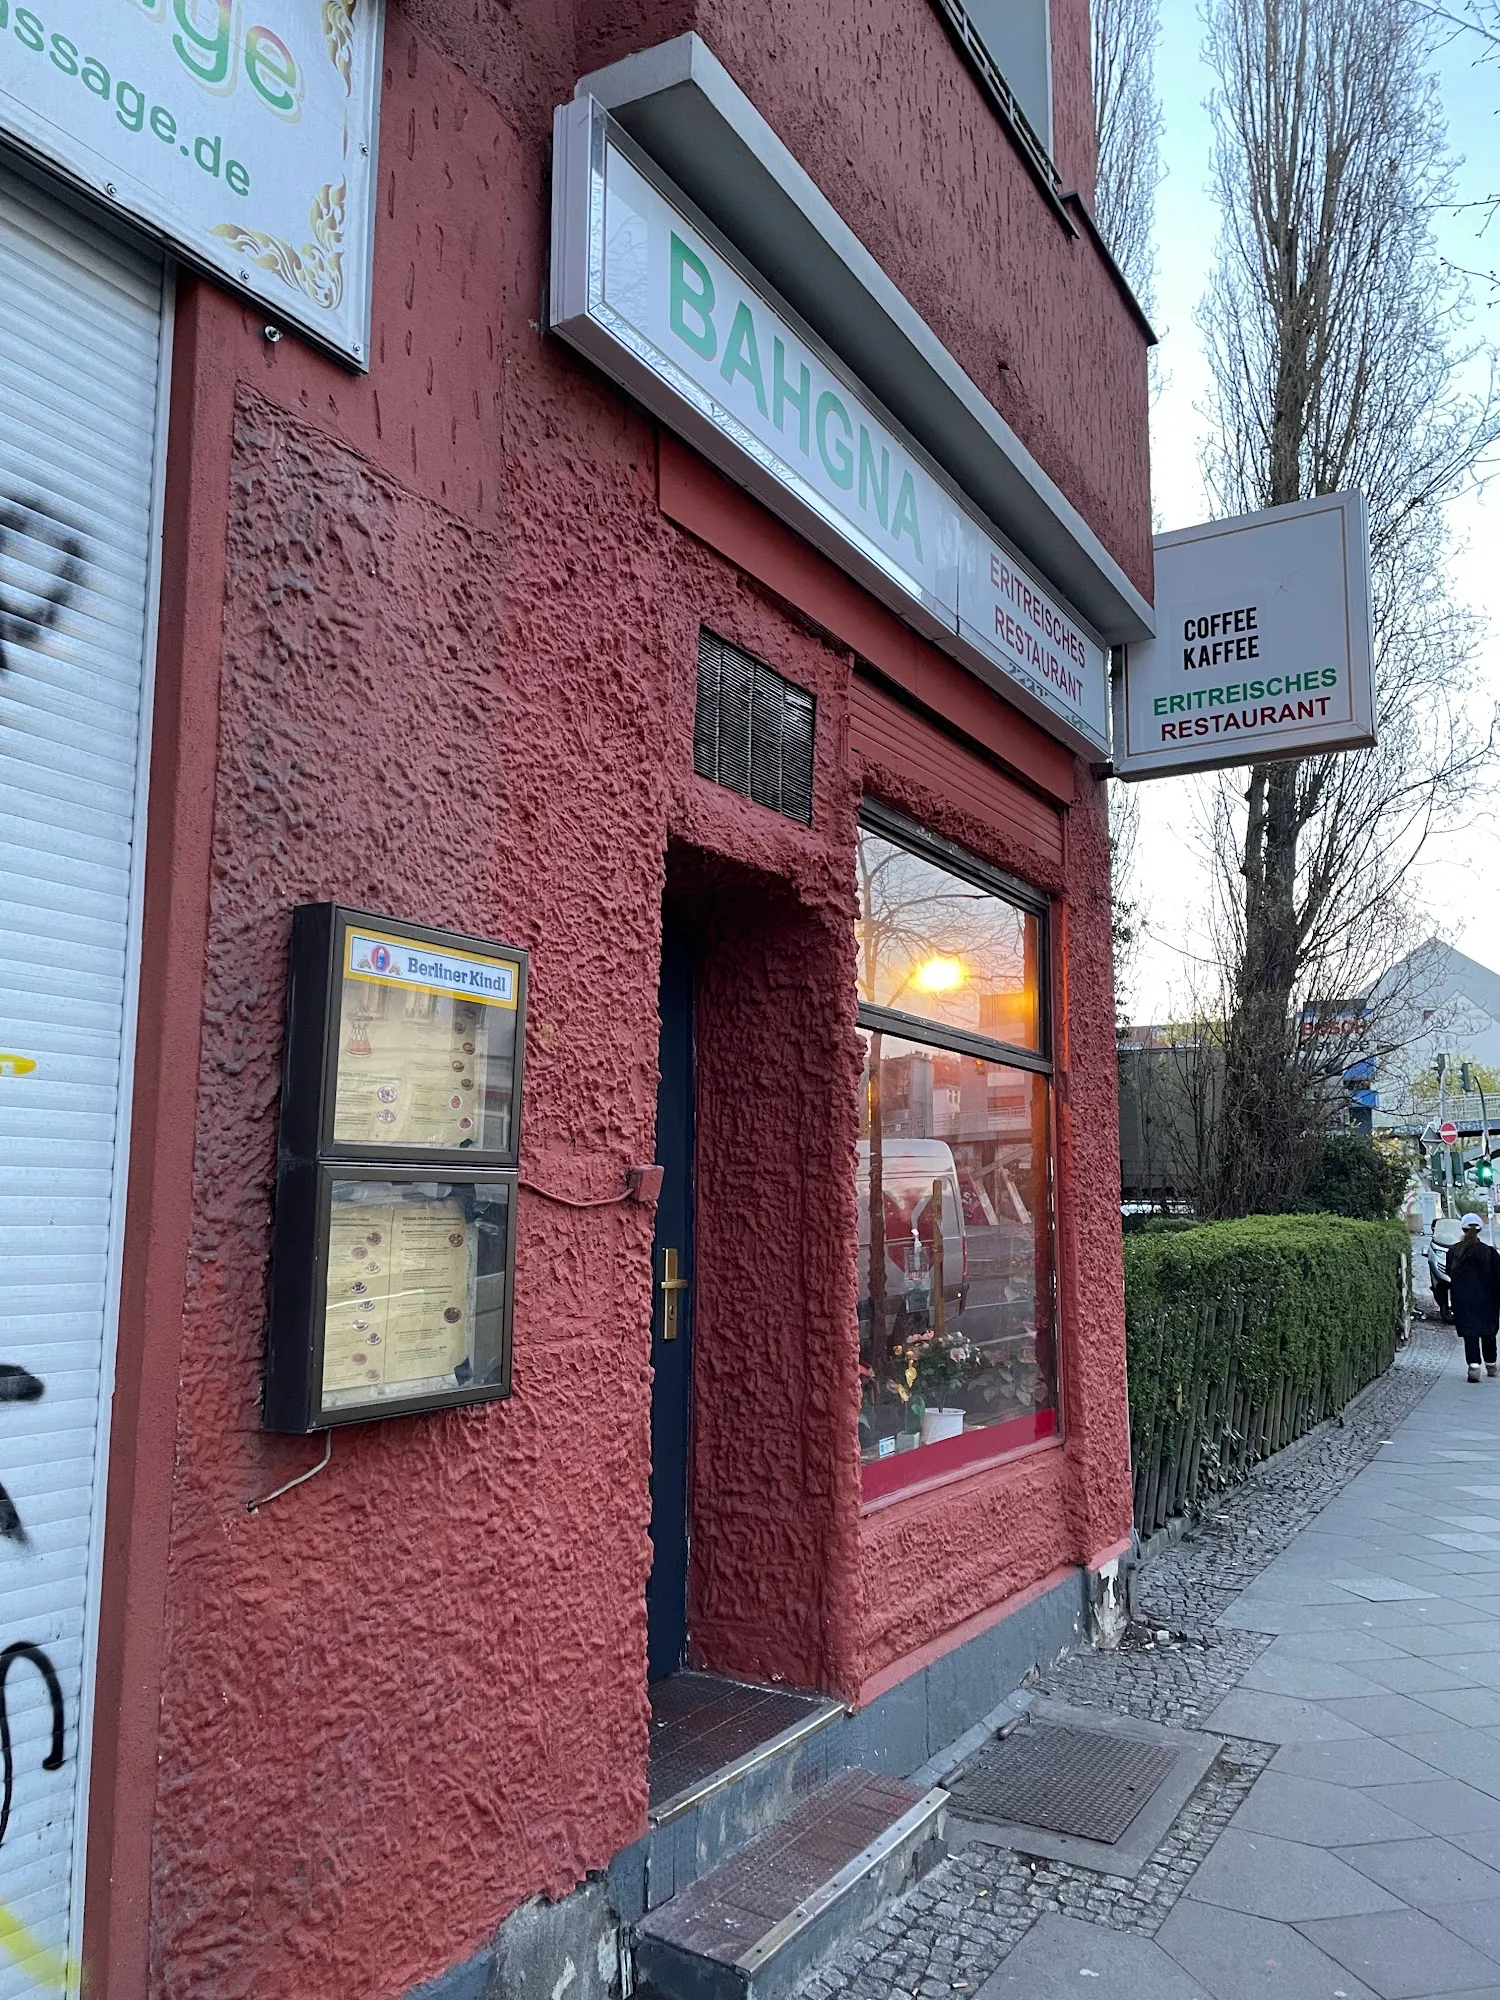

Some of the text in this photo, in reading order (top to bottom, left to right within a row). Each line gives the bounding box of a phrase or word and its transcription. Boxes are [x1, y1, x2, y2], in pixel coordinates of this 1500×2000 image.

[142, 0, 298, 112] ge
[669, 230, 924, 565] BAHGNA
[990, 552, 1085, 669] ERITREISCHES
[1184, 607, 1258, 641] COFFEE
[995, 604, 1083, 706] RESTAURANT
[1183, 635, 1259, 671] KAFFEE
[1153, 667, 1337, 716] ERITREISCHES
[1161, 696, 1331, 741] RESTAURANT
[407, 956, 506, 992] Berliner Kindl
